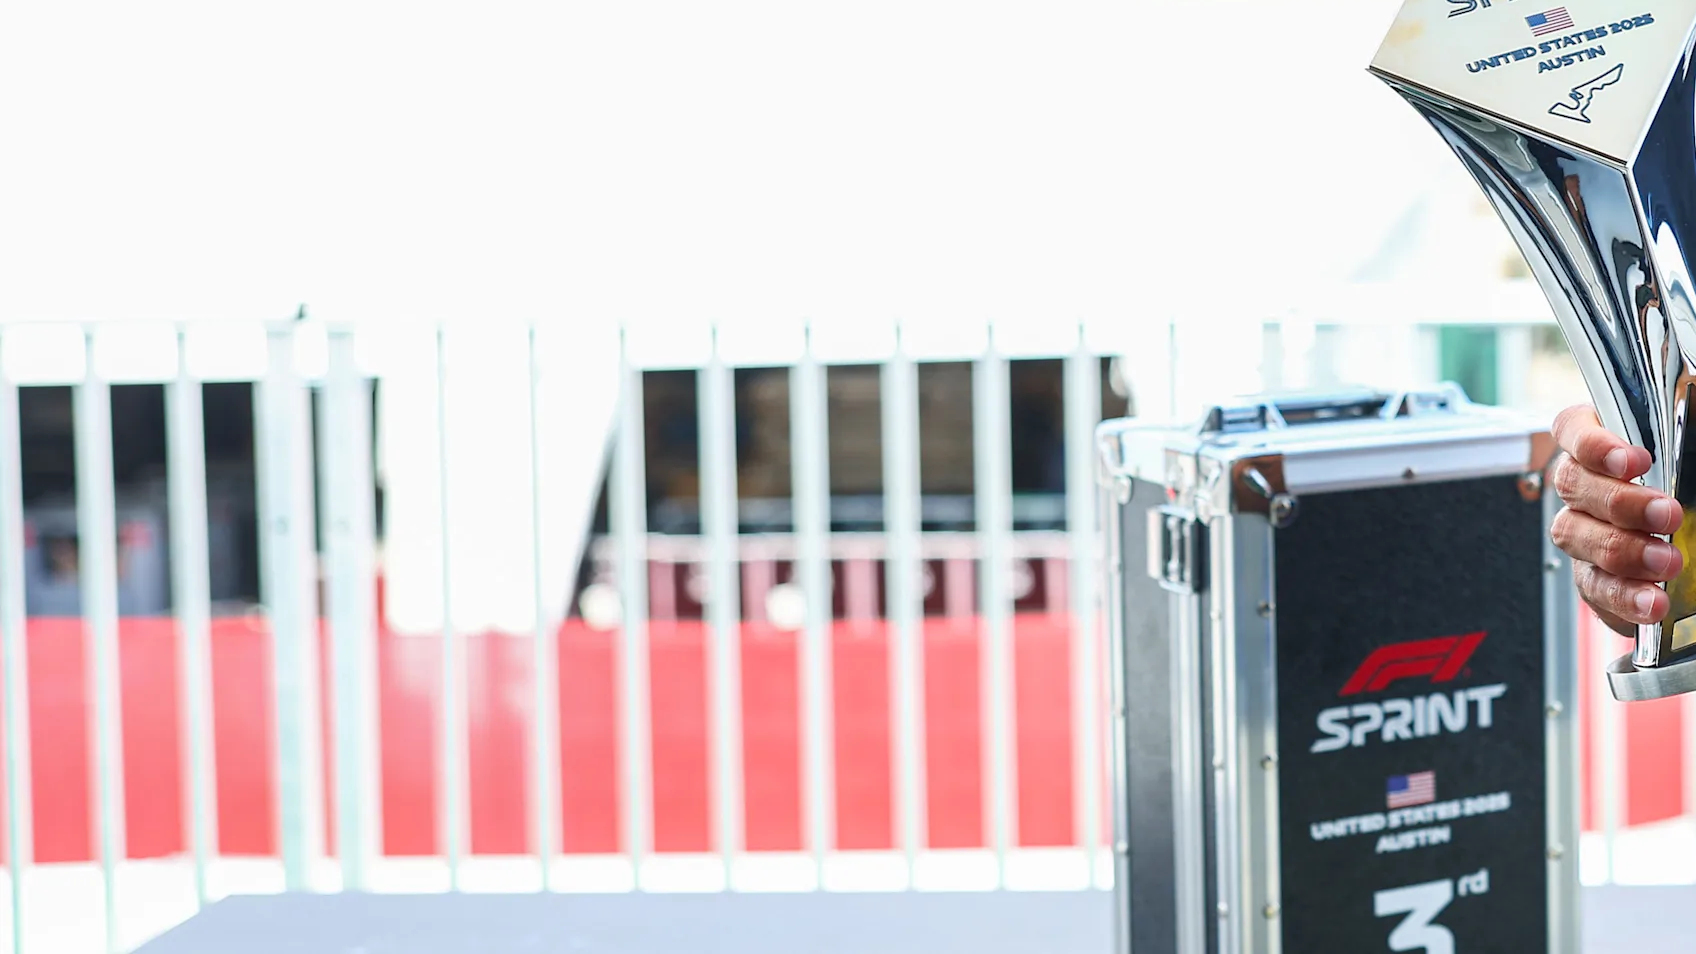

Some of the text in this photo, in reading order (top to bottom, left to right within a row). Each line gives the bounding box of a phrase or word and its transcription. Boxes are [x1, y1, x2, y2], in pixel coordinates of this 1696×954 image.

[1466, 13, 1655, 73] UNITED STATES 2025
[1538, 45, 1606, 73] AUSTIN
[1337, 631, 1487, 696] F1
[1310, 683, 1507, 753] SPRINT
[1310, 812, 1387, 841] UNITED
[1388, 799, 1460, 828] STATES
[1375, 825, 1451, 854] AUSTIN
